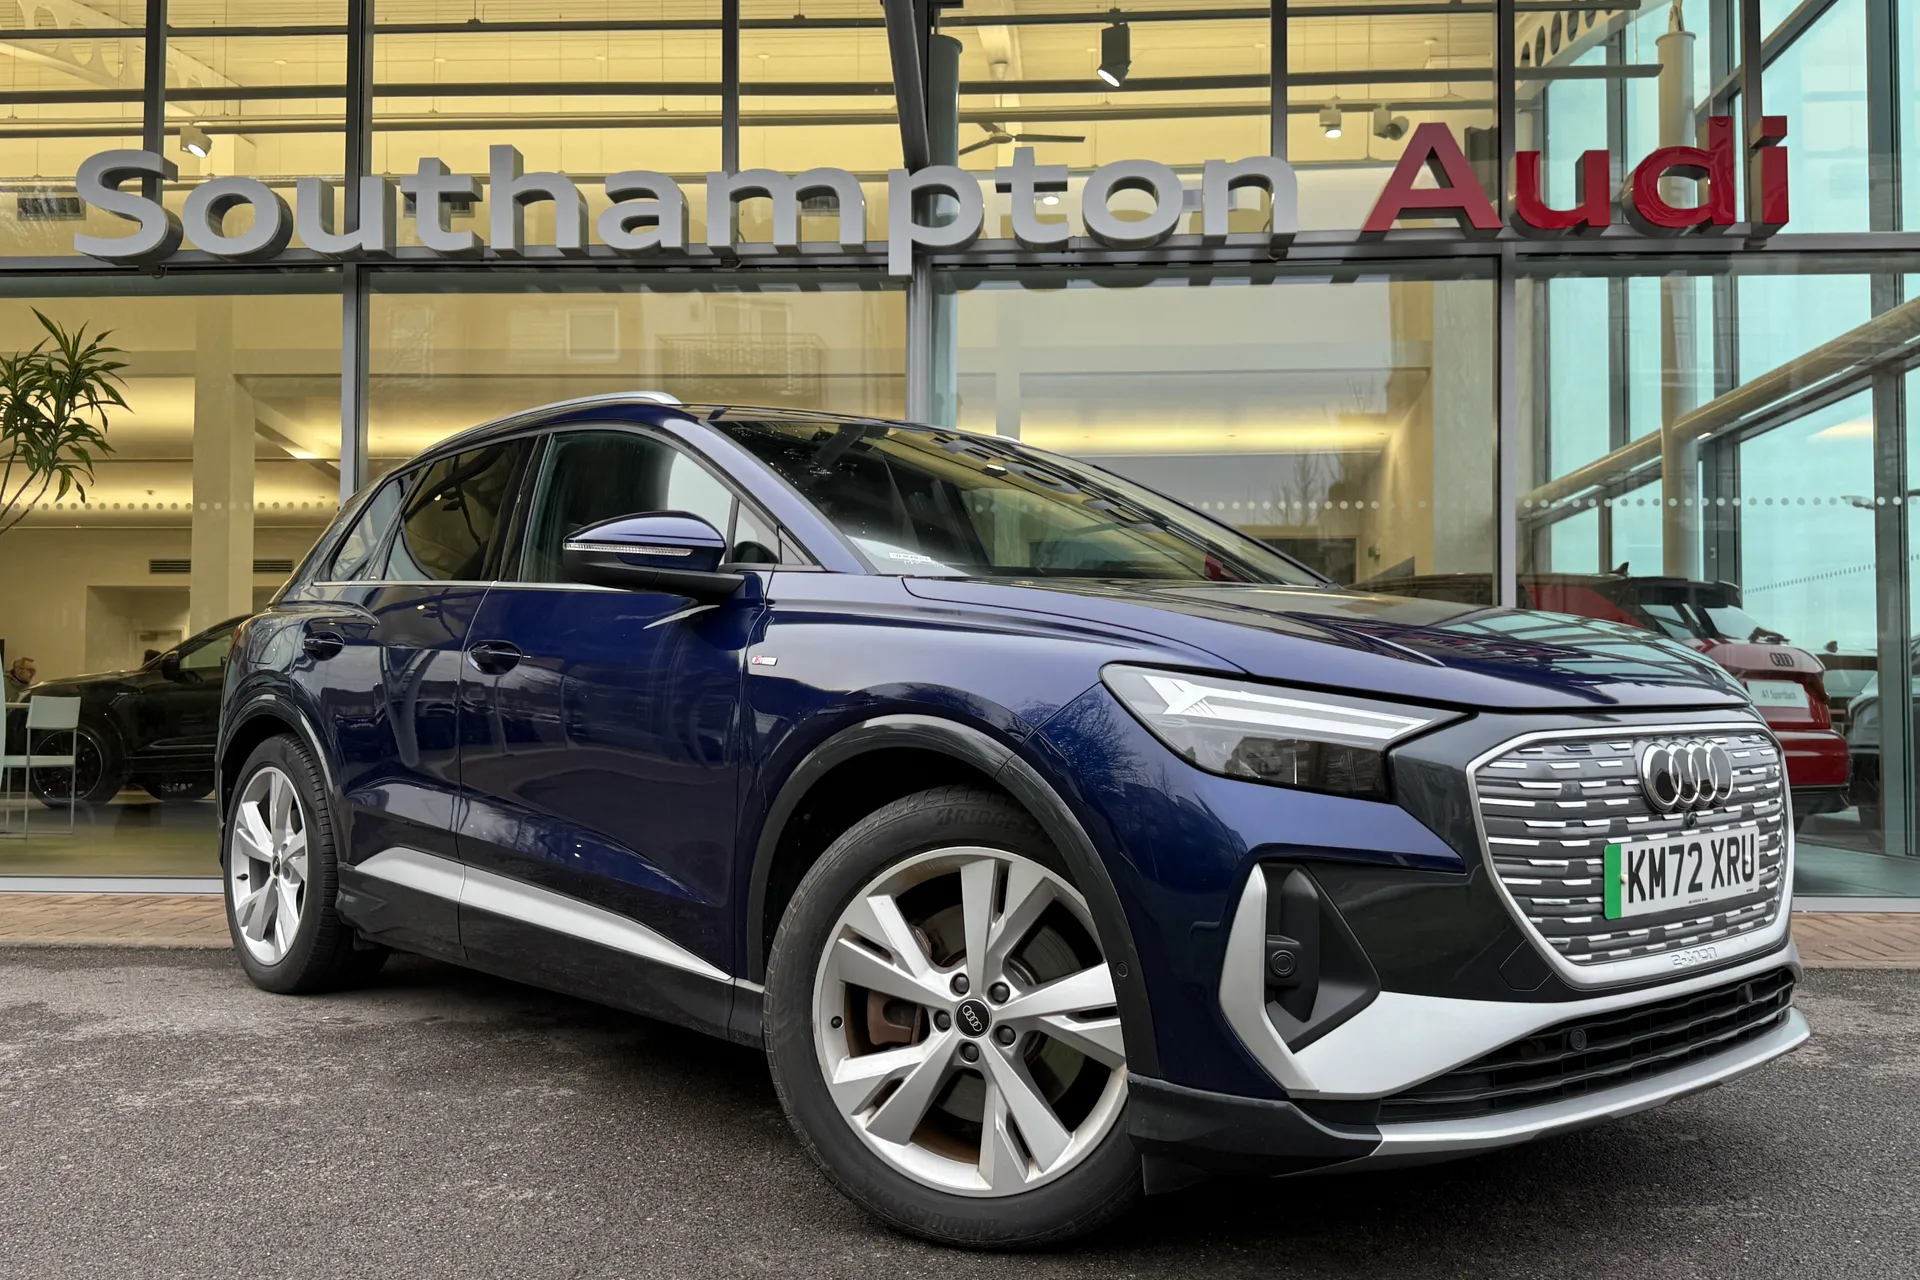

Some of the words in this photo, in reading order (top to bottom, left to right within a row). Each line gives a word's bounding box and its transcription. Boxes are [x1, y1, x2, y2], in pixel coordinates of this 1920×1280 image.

[73, 144, 1299, 281] Southampton
[1361, 114, 1790, 238] Audi
[1627, 842, 1703, 904] KM72
[1710, 833, 1755, 890] XRU
